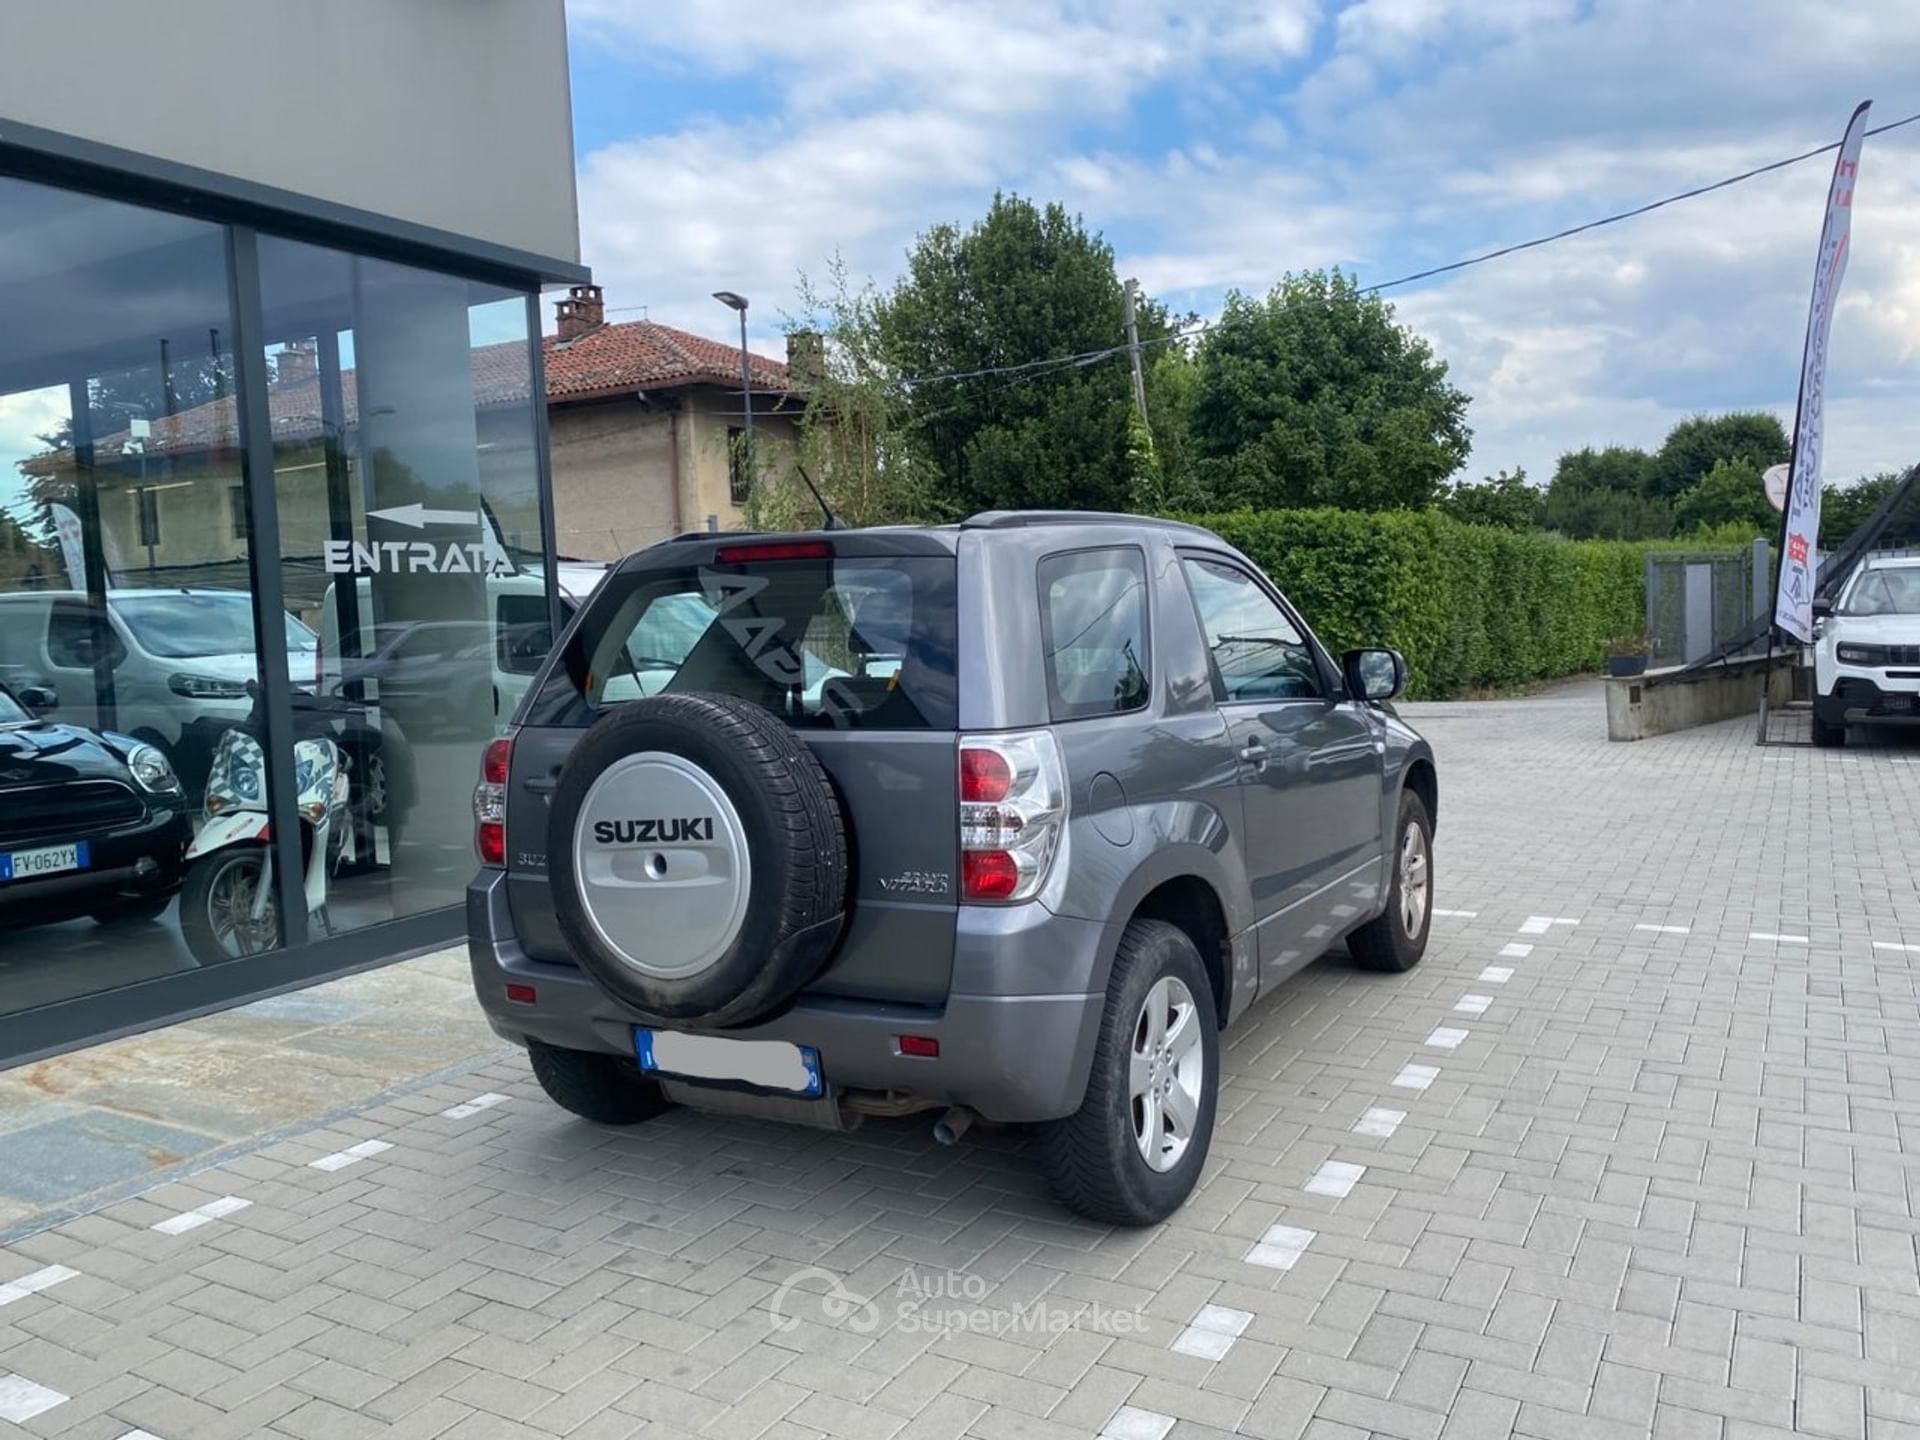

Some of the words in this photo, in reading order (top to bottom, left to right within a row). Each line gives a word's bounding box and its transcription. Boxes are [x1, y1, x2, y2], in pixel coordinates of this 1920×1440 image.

[323, 540, 516, 574] ENTRATA
[594, 817, 714, 844] SUZUKI
[518, 851, 547, 867] SUZ
